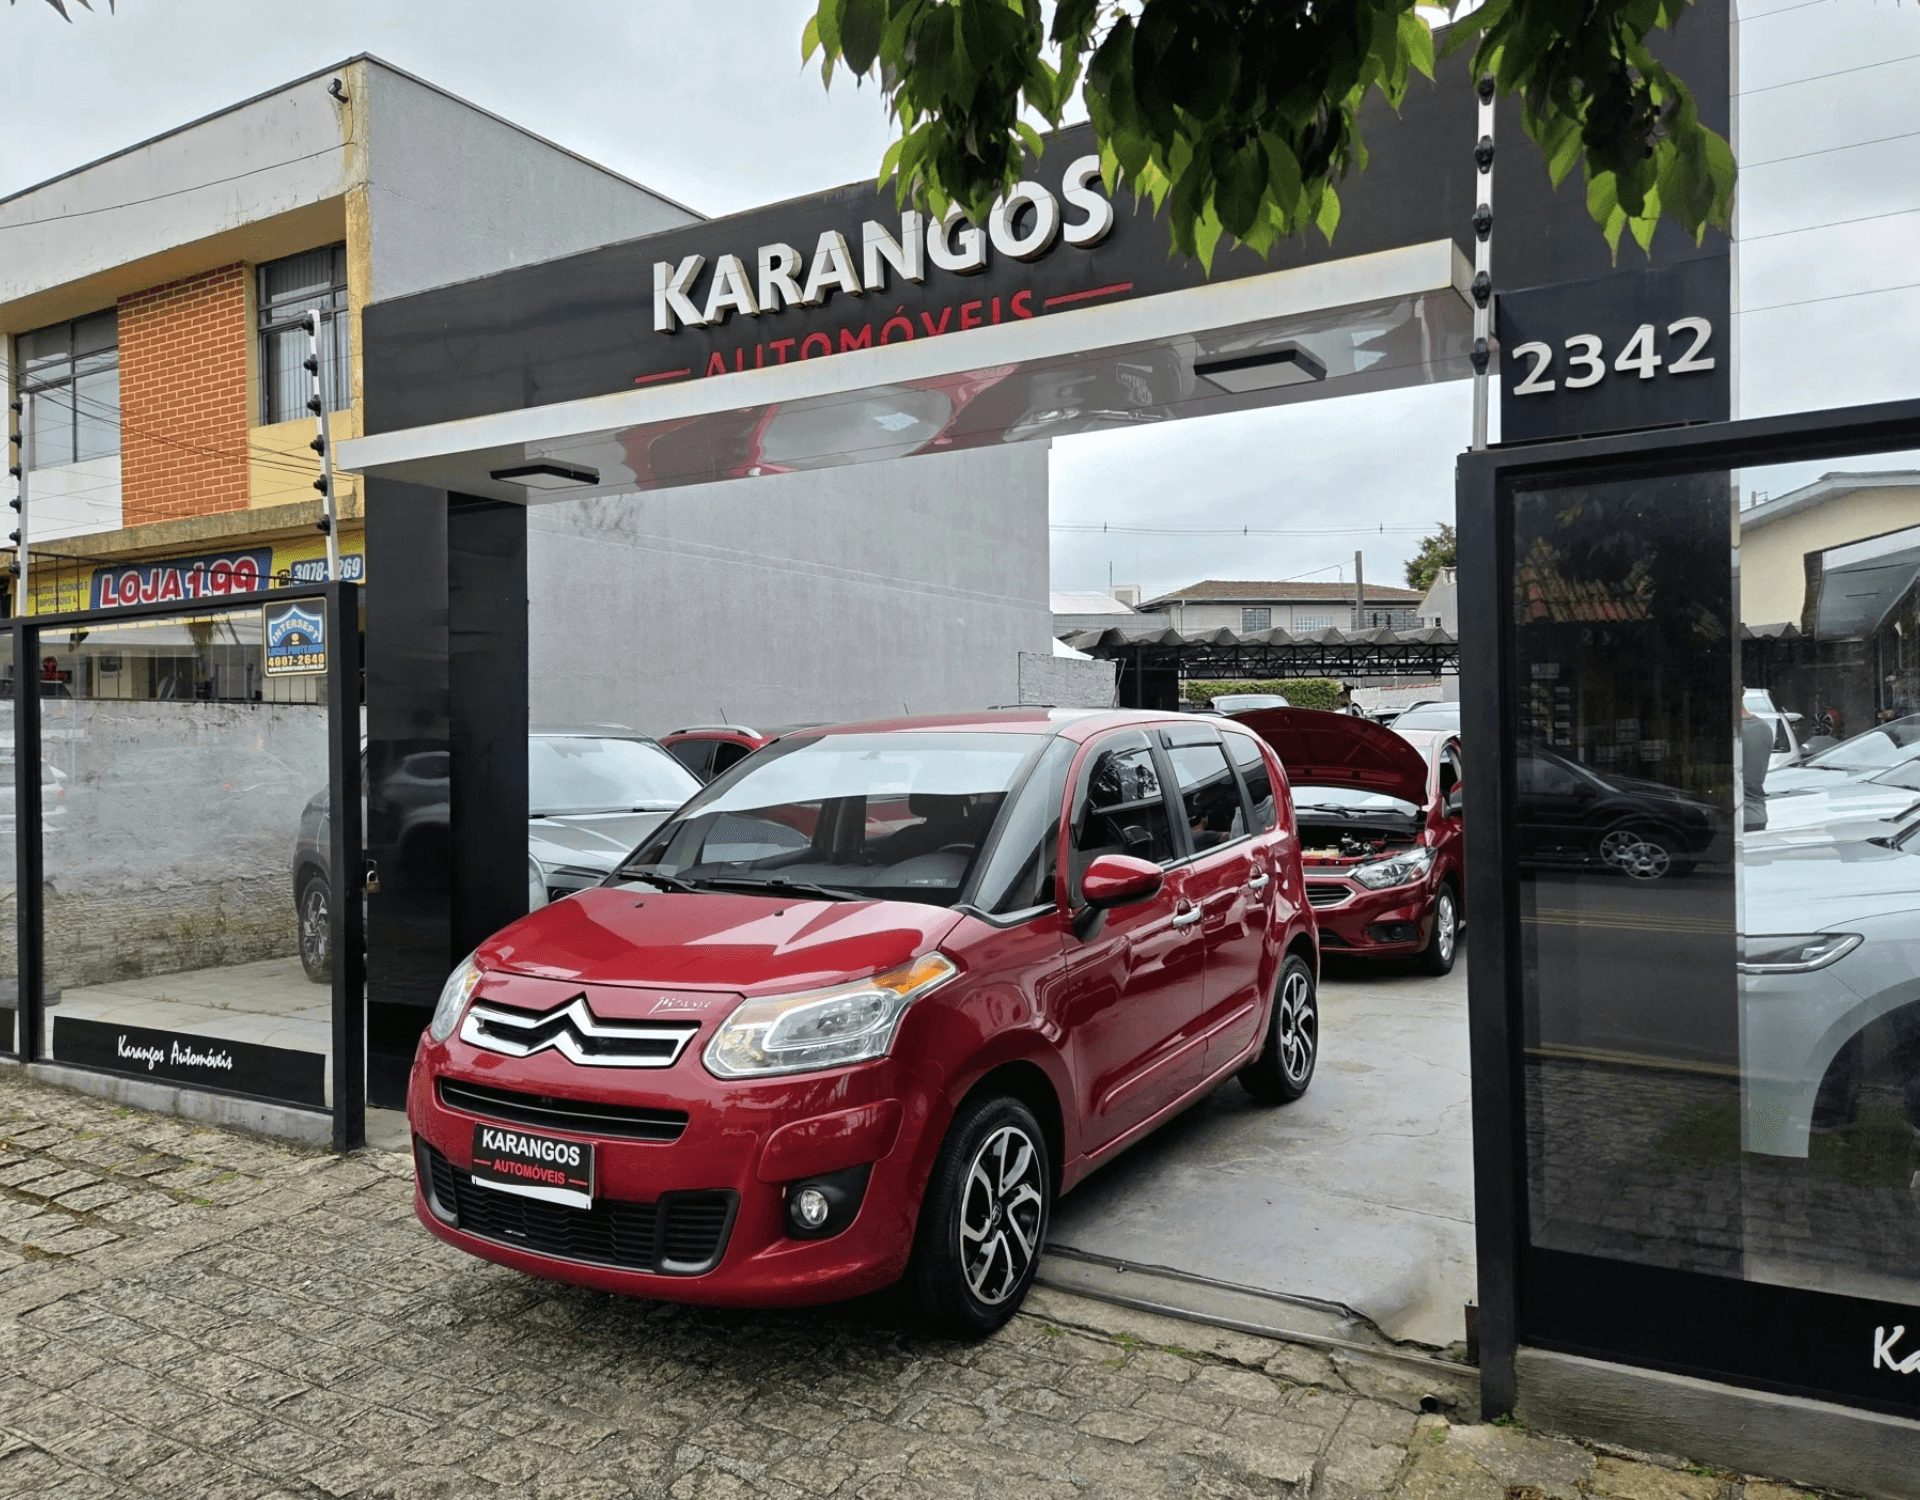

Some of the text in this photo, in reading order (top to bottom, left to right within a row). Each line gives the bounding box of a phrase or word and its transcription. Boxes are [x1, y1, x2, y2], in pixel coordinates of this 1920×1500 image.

[653, 154, 1112, 334] KARANGOS
[1512, 316, 1715, 396] 2342
[99, 566, 184, 609] LOJA
[289, 557, 361, 584] 3078-269
[272, 618, 319, 642] INTERSEPT
[118, 1034, 233, 1071] Karangos Automóveis
[482, 1128, 580, 1167] KARANGOS
[493, 1158, 566, 1186] AUTOMÓVEIS
